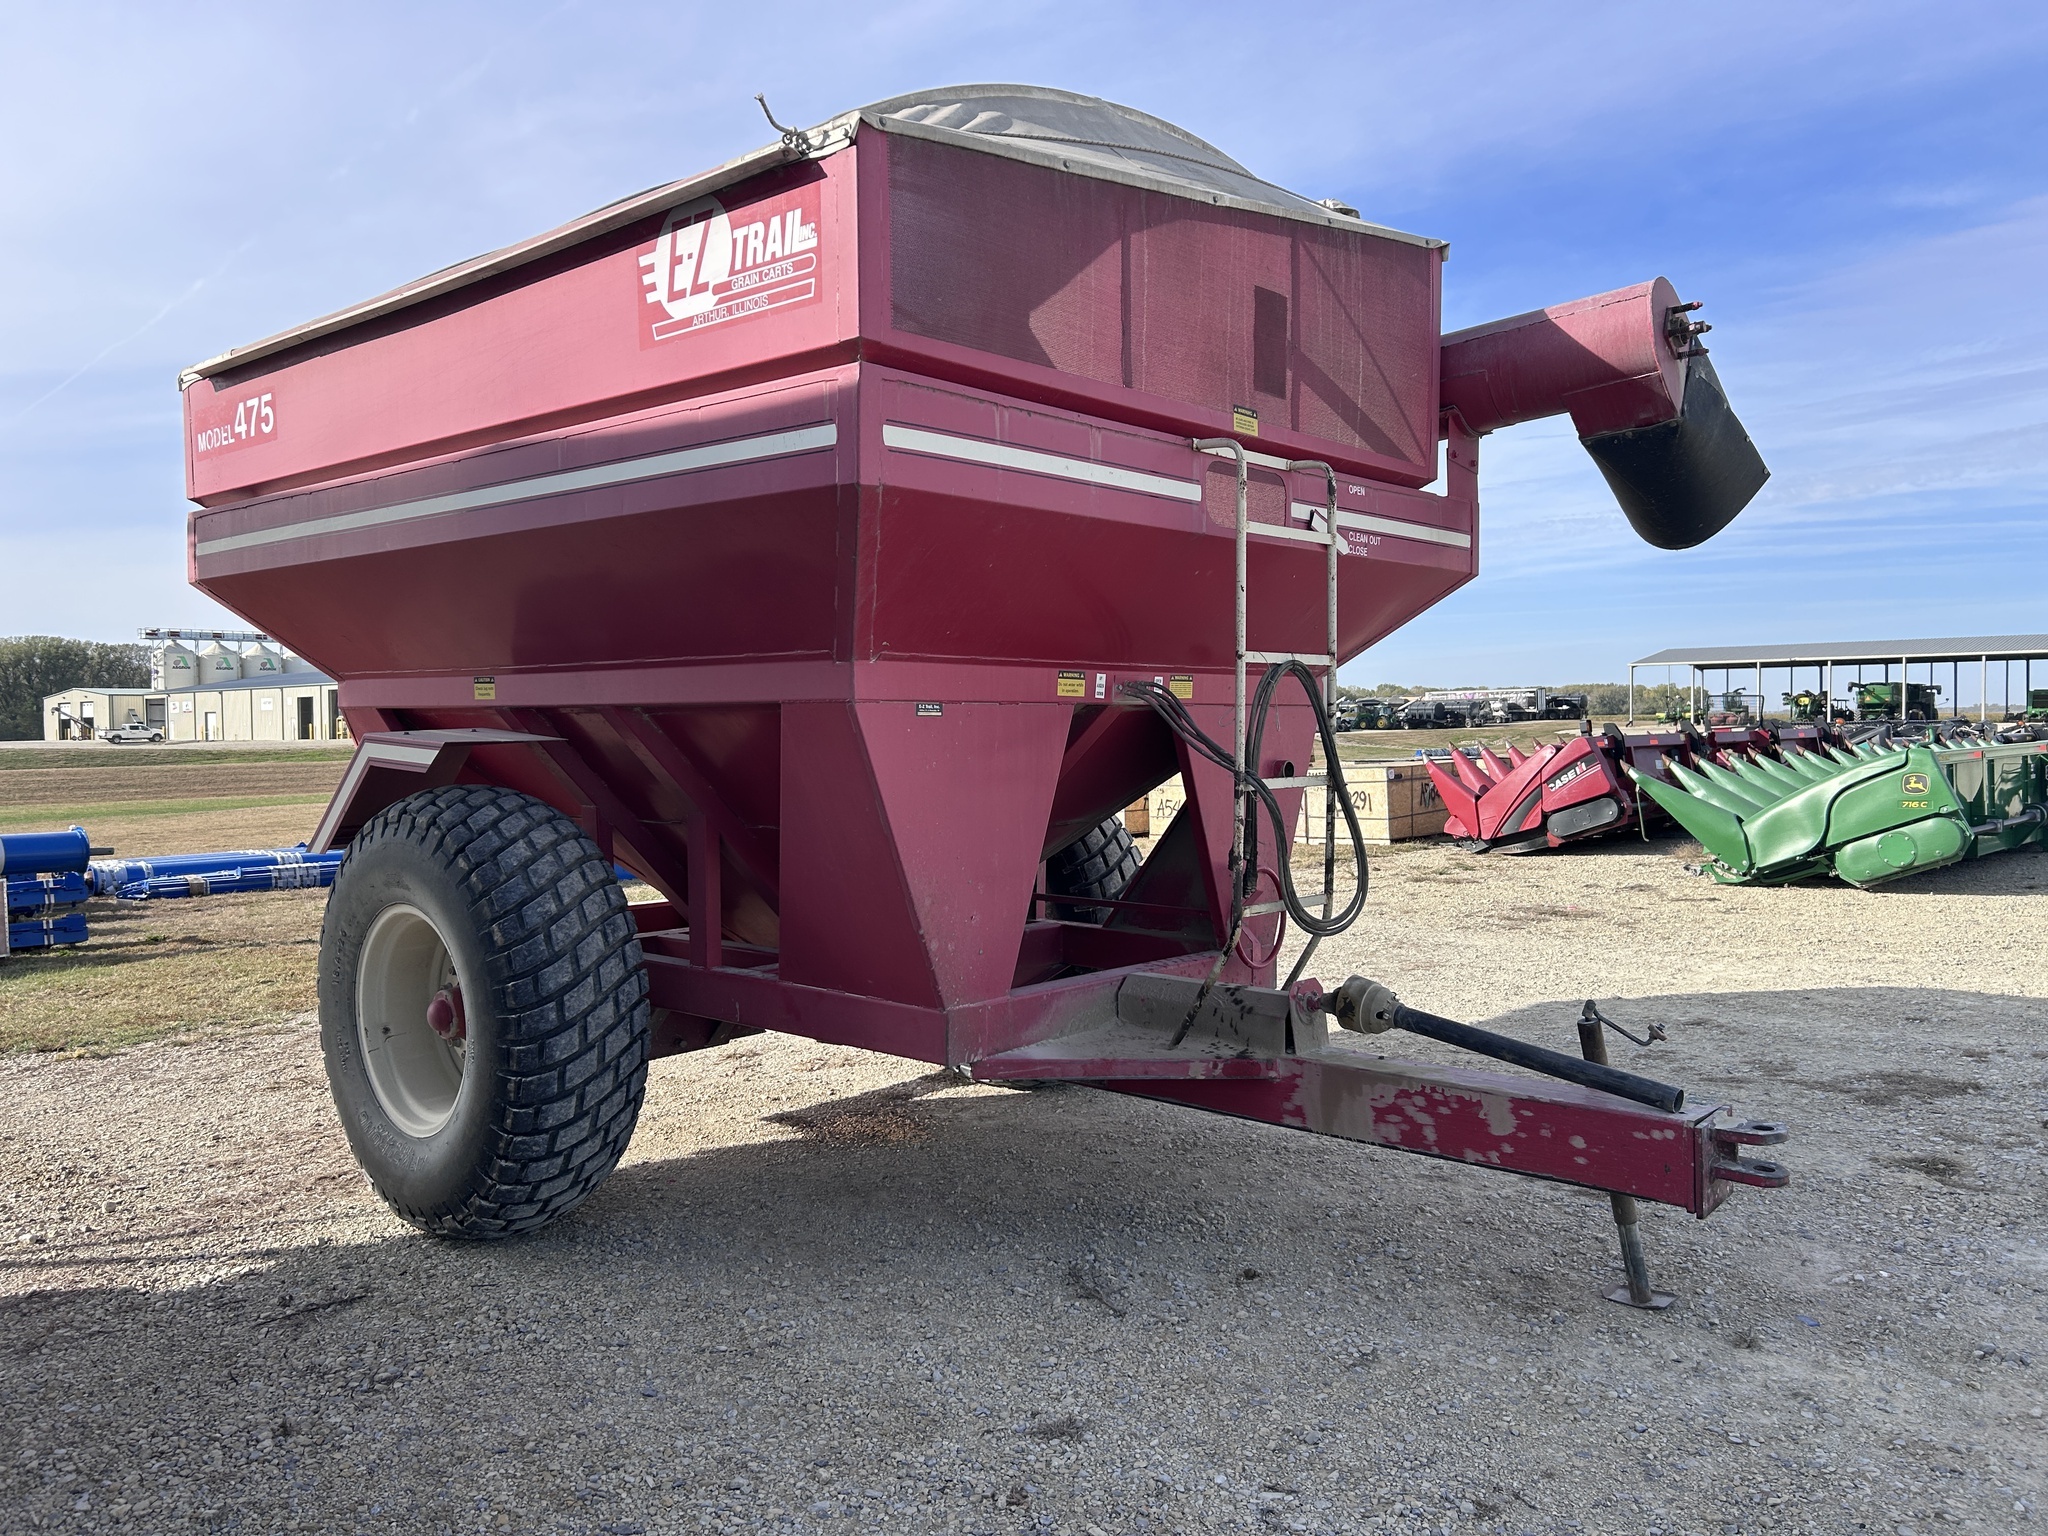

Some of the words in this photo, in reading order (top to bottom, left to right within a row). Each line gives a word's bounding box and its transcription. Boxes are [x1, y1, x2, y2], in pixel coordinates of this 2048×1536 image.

[733, 207, 817, 272] TRAIL
[731, 271, 760, 291] GRAIN
[762, 262, 794, 282] CARTS
[692, 306, 730, 327] ARTHUR,
[732, 294, 769, 316] ILLINOIS
[197, 424, 235, 453] MODEL
[234, 392, 274, 440] 475
[1348, 485, 1366, 496] OPEN
[1348, 531, 1368, 544] CLEAN
[1369, 535, 1382, 546] OUT
[1348, 544, 1368, 556] CLOSE
[1548, 768, 1577, 792] CASE
